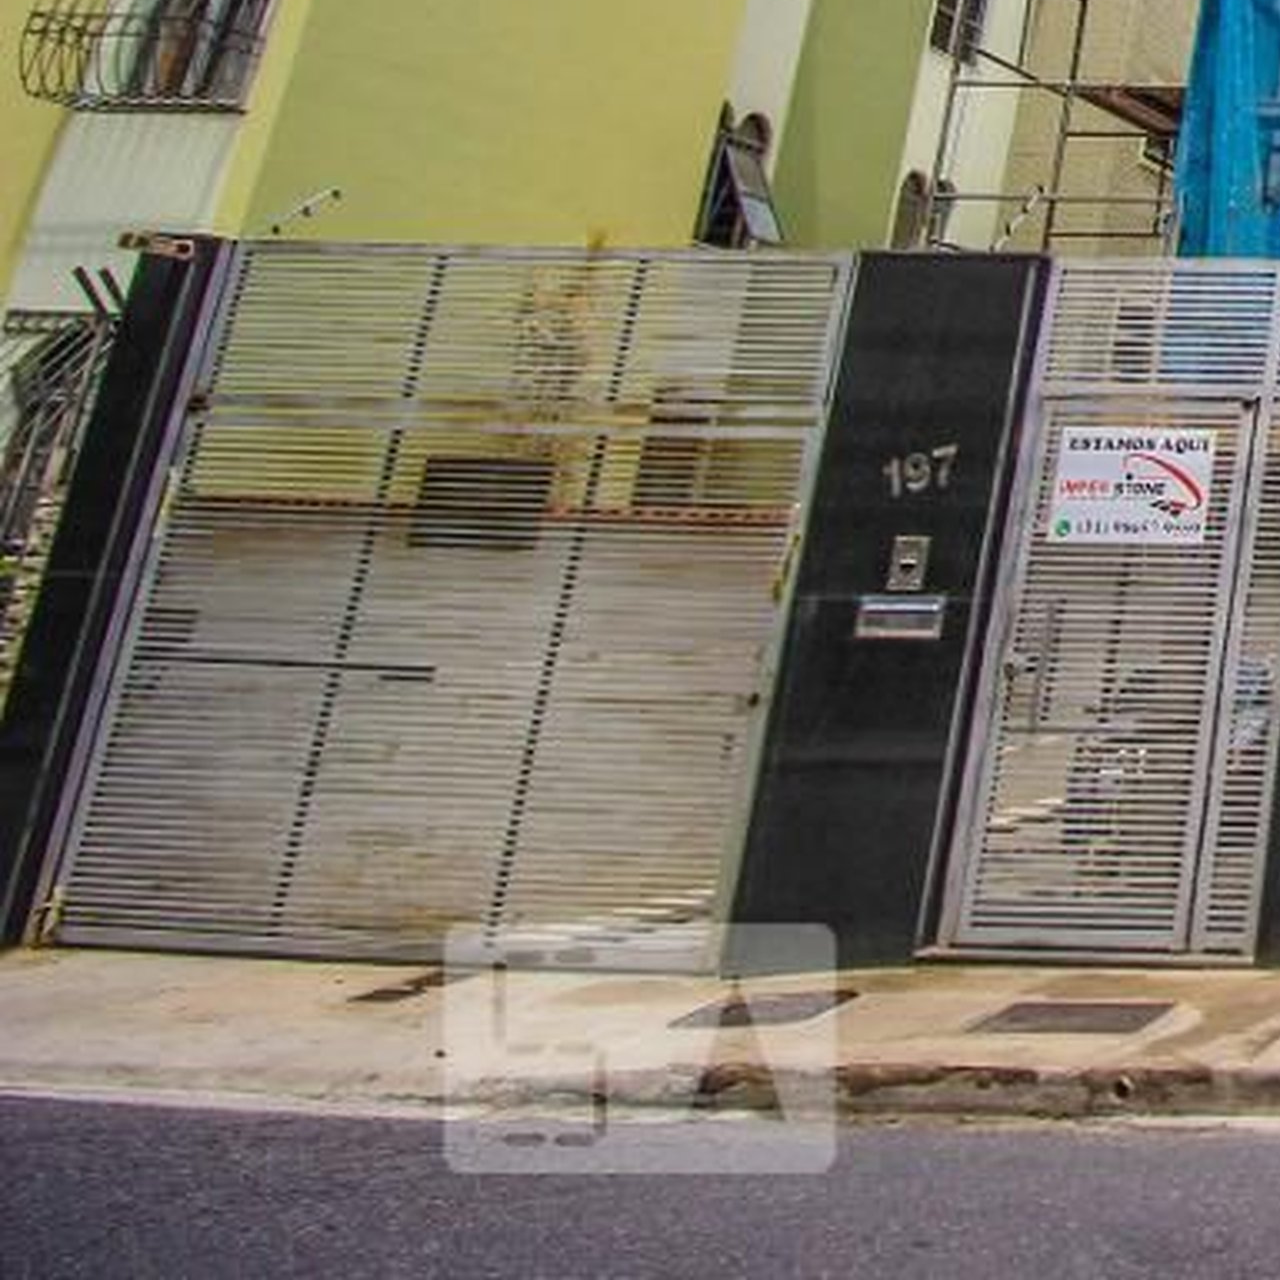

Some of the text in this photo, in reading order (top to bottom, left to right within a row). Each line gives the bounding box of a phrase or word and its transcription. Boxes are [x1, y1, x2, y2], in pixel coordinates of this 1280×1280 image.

[1069, 437, 1208, 454] ESTAMOS AQUI
[882, 443, 958, 499] 197
